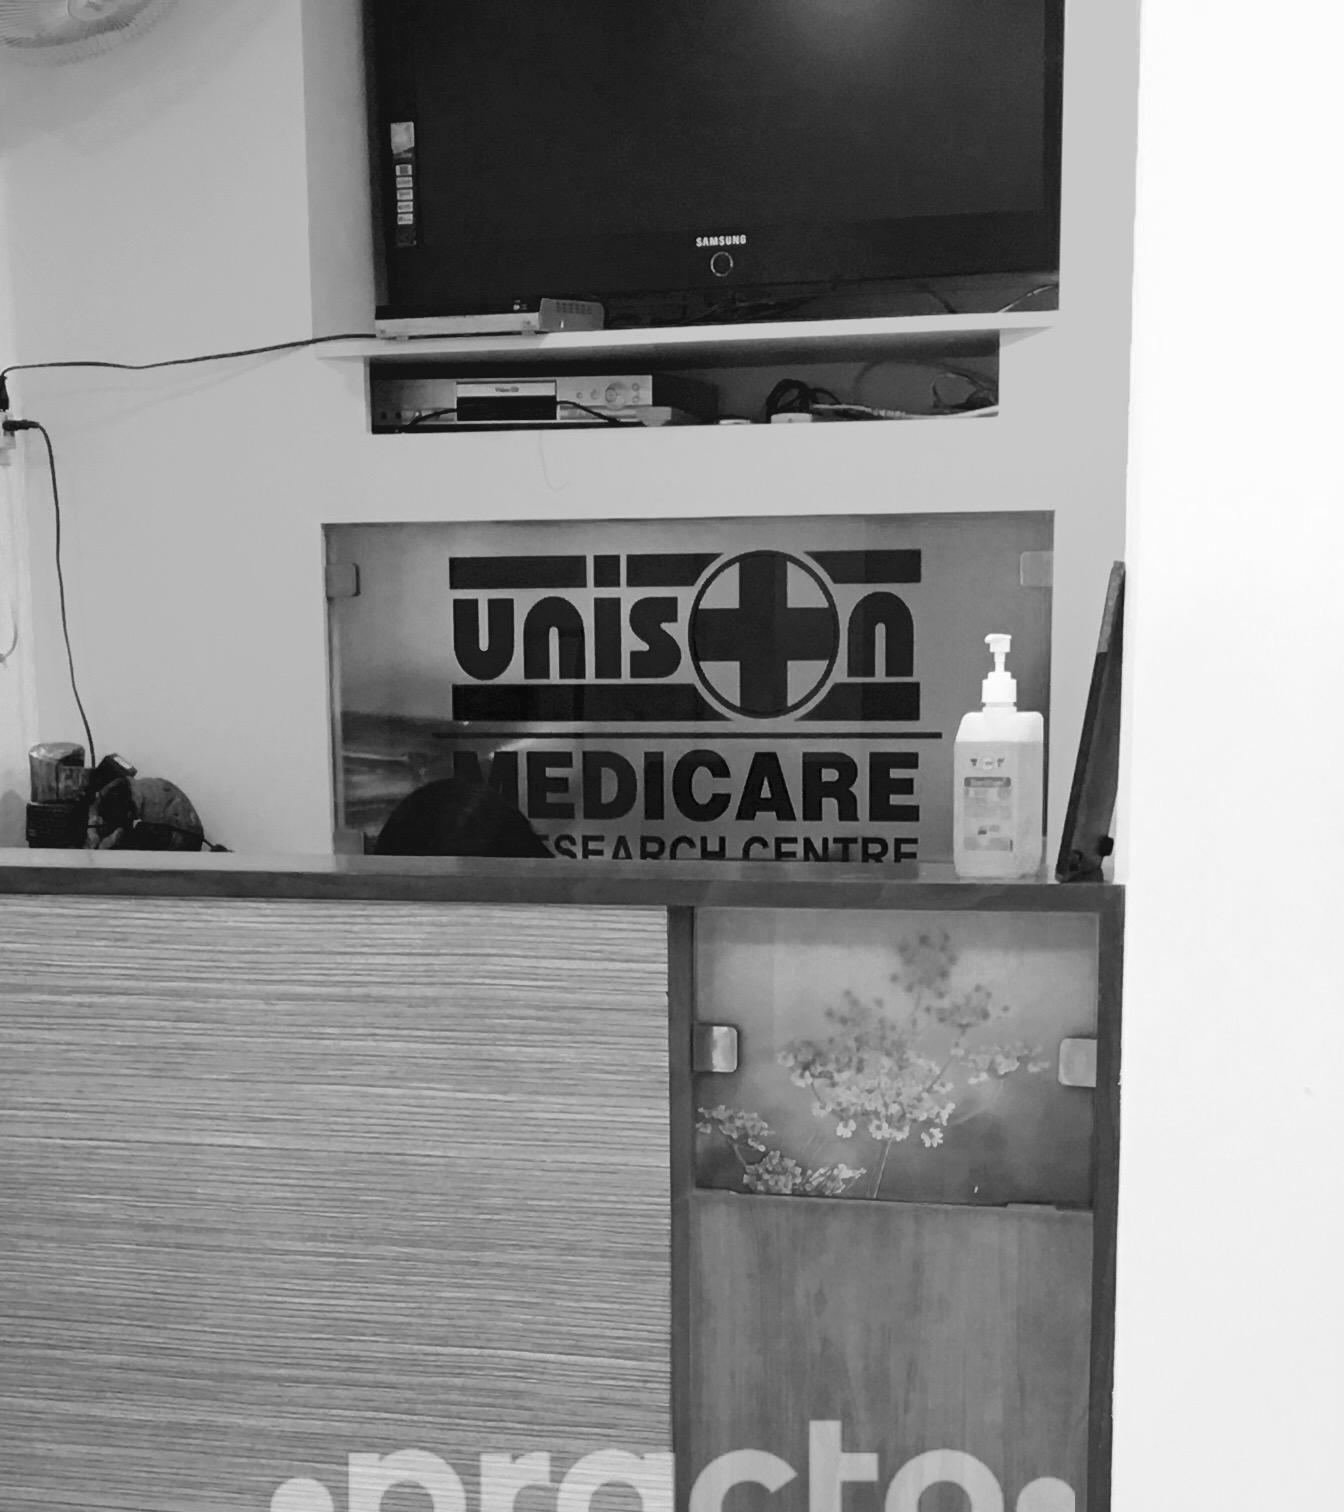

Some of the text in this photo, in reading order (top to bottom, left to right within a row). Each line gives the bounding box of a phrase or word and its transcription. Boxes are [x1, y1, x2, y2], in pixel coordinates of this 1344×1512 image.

[696, 234, 747, 247] SAMSUNG
[453, 749, 920, 822] MEDICARE
[538, 834, 920, 863] SEARCH CENTRE
